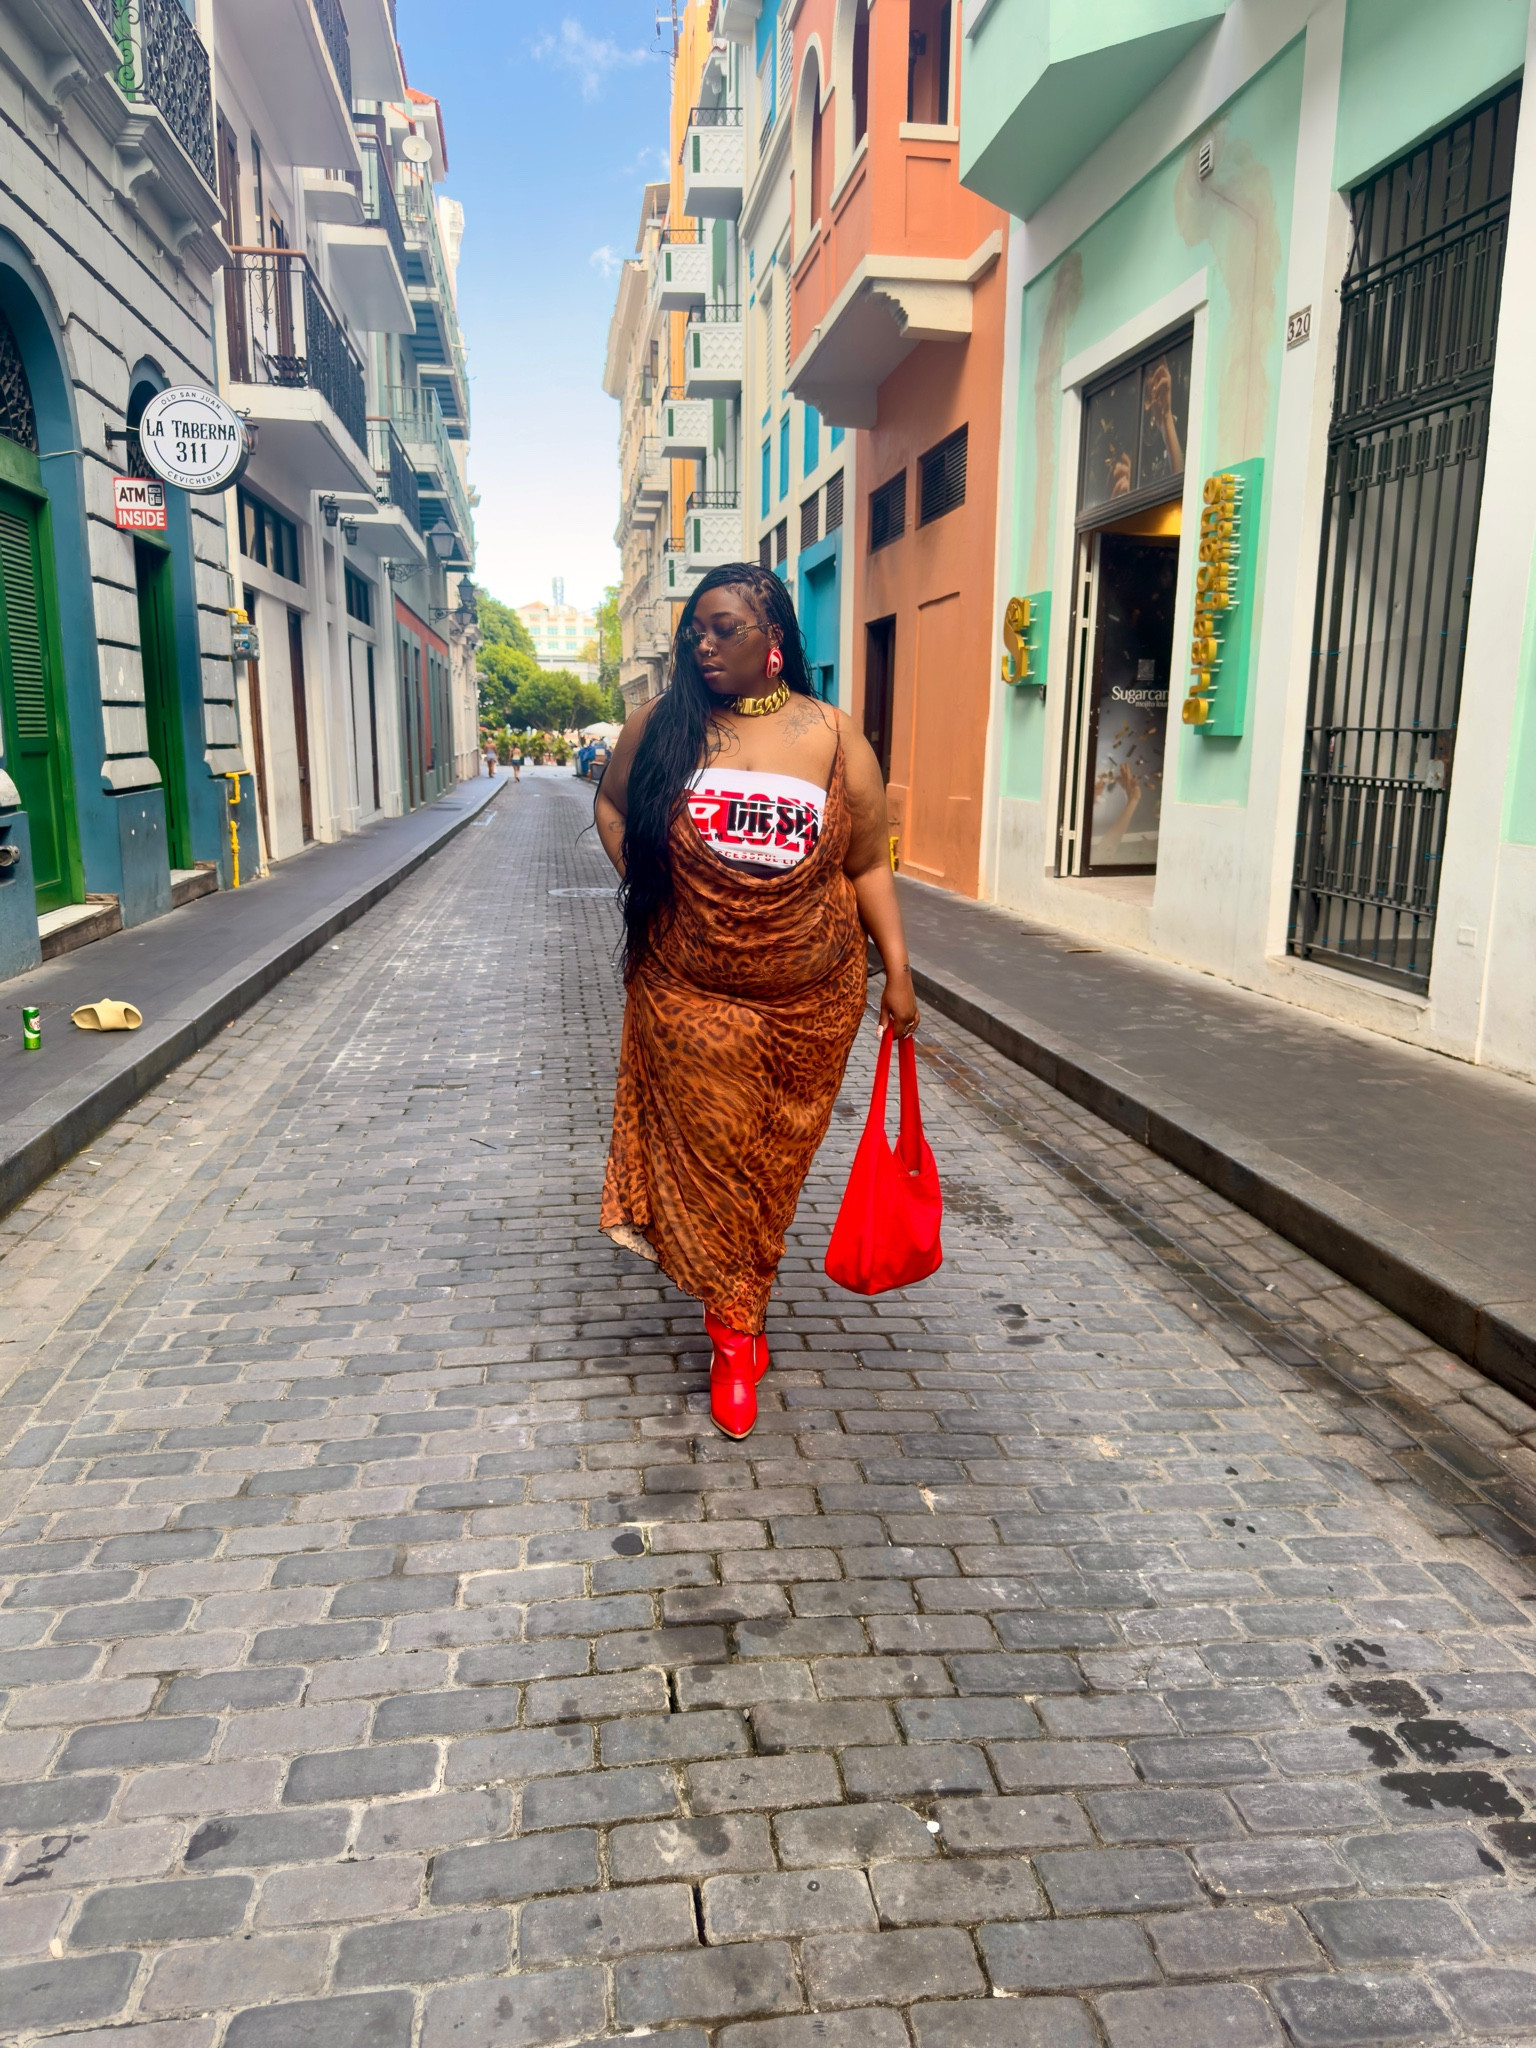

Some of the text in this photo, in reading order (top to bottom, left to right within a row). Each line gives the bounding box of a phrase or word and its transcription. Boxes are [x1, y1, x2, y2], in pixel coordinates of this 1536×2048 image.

[1288, 312, 1311, 342] 320
[161, 394, 177, 406] OLD
[200, 395, 222, 410] JUAN
[146, 418, 237, 441] LA TABERNA
[175, 441, 207, 464] 311
[167, 470, 222, 485] CEVICHERIA
[119, 486, 146, 503] ATM
[118, 510, 165, 527] INSIDE
